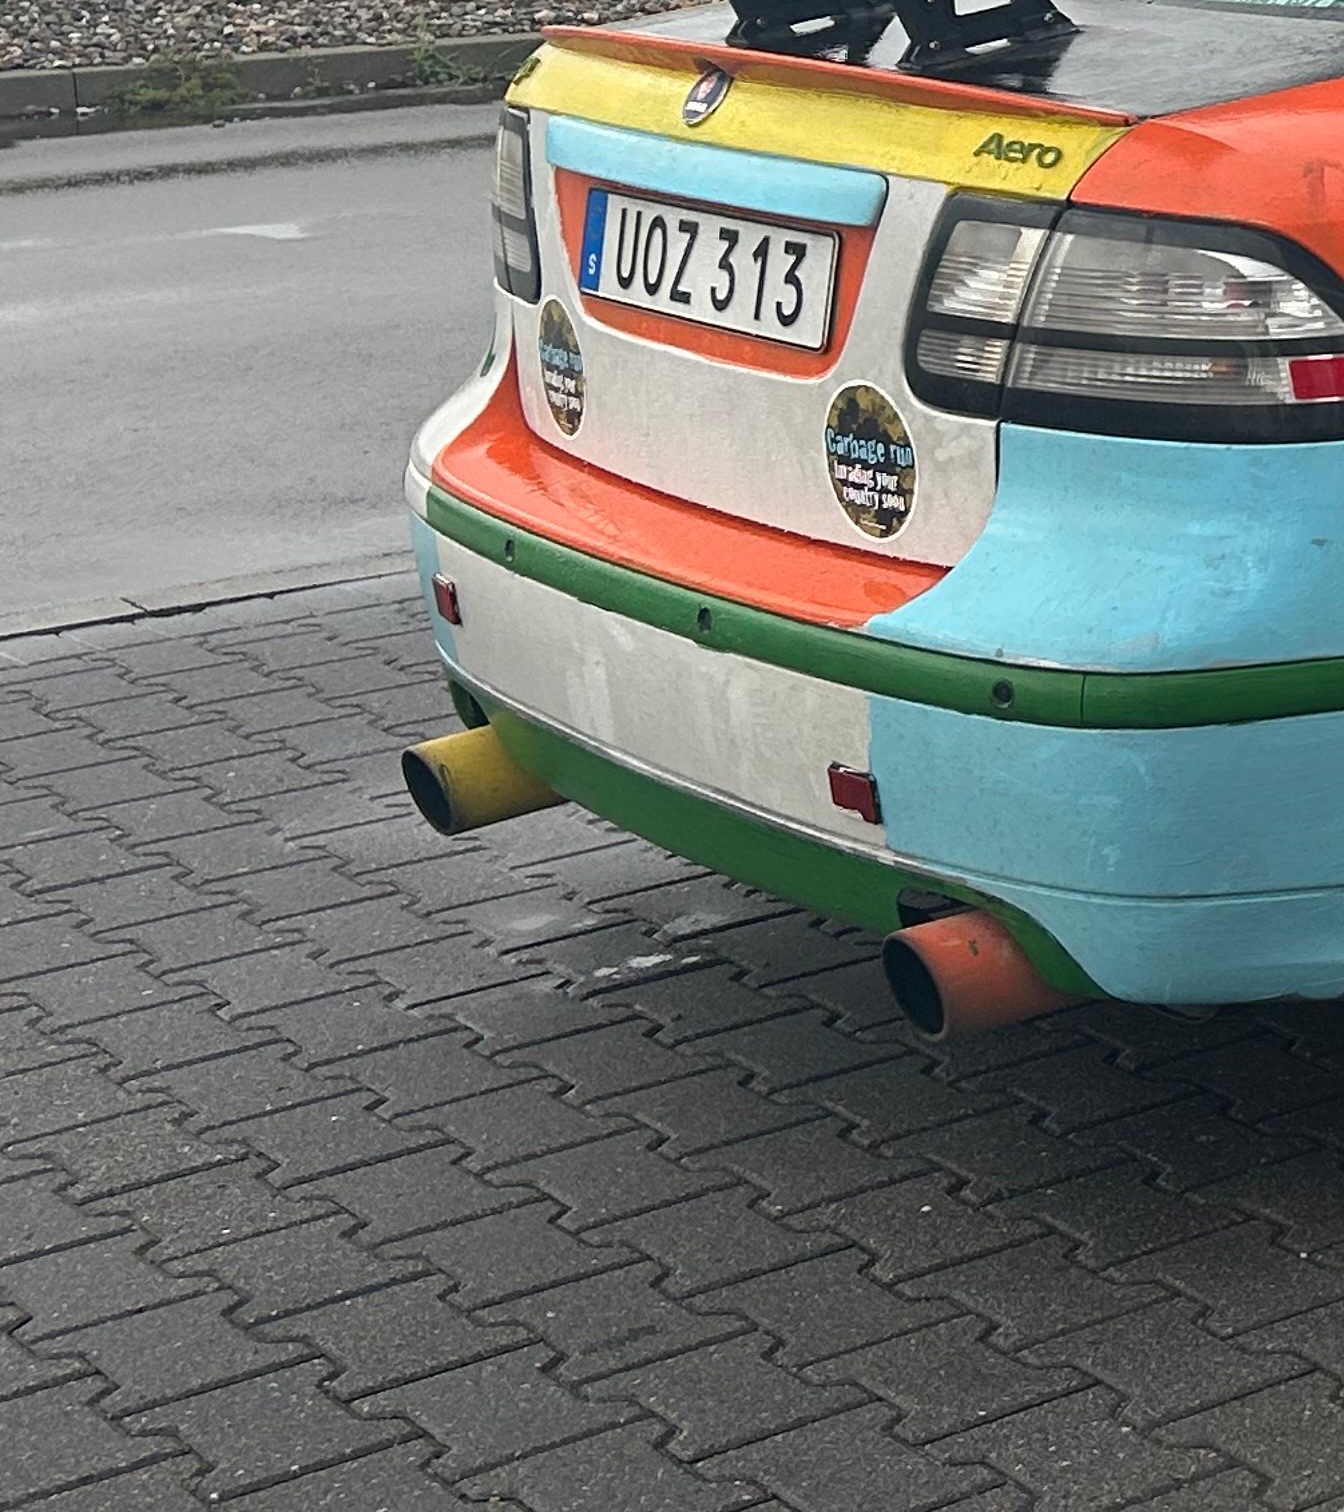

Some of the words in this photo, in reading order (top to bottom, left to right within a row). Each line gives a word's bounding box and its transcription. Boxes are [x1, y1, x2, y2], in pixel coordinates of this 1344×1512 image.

[973, 132, 1062, 169] Aero
[588, 254, 598, 276] S
[615, 207, 700, 305] UOZ
[710, 227, 807, 327] 313
[826, 427, 885, 464] Carbage
[889, 444, 913, 467] run
